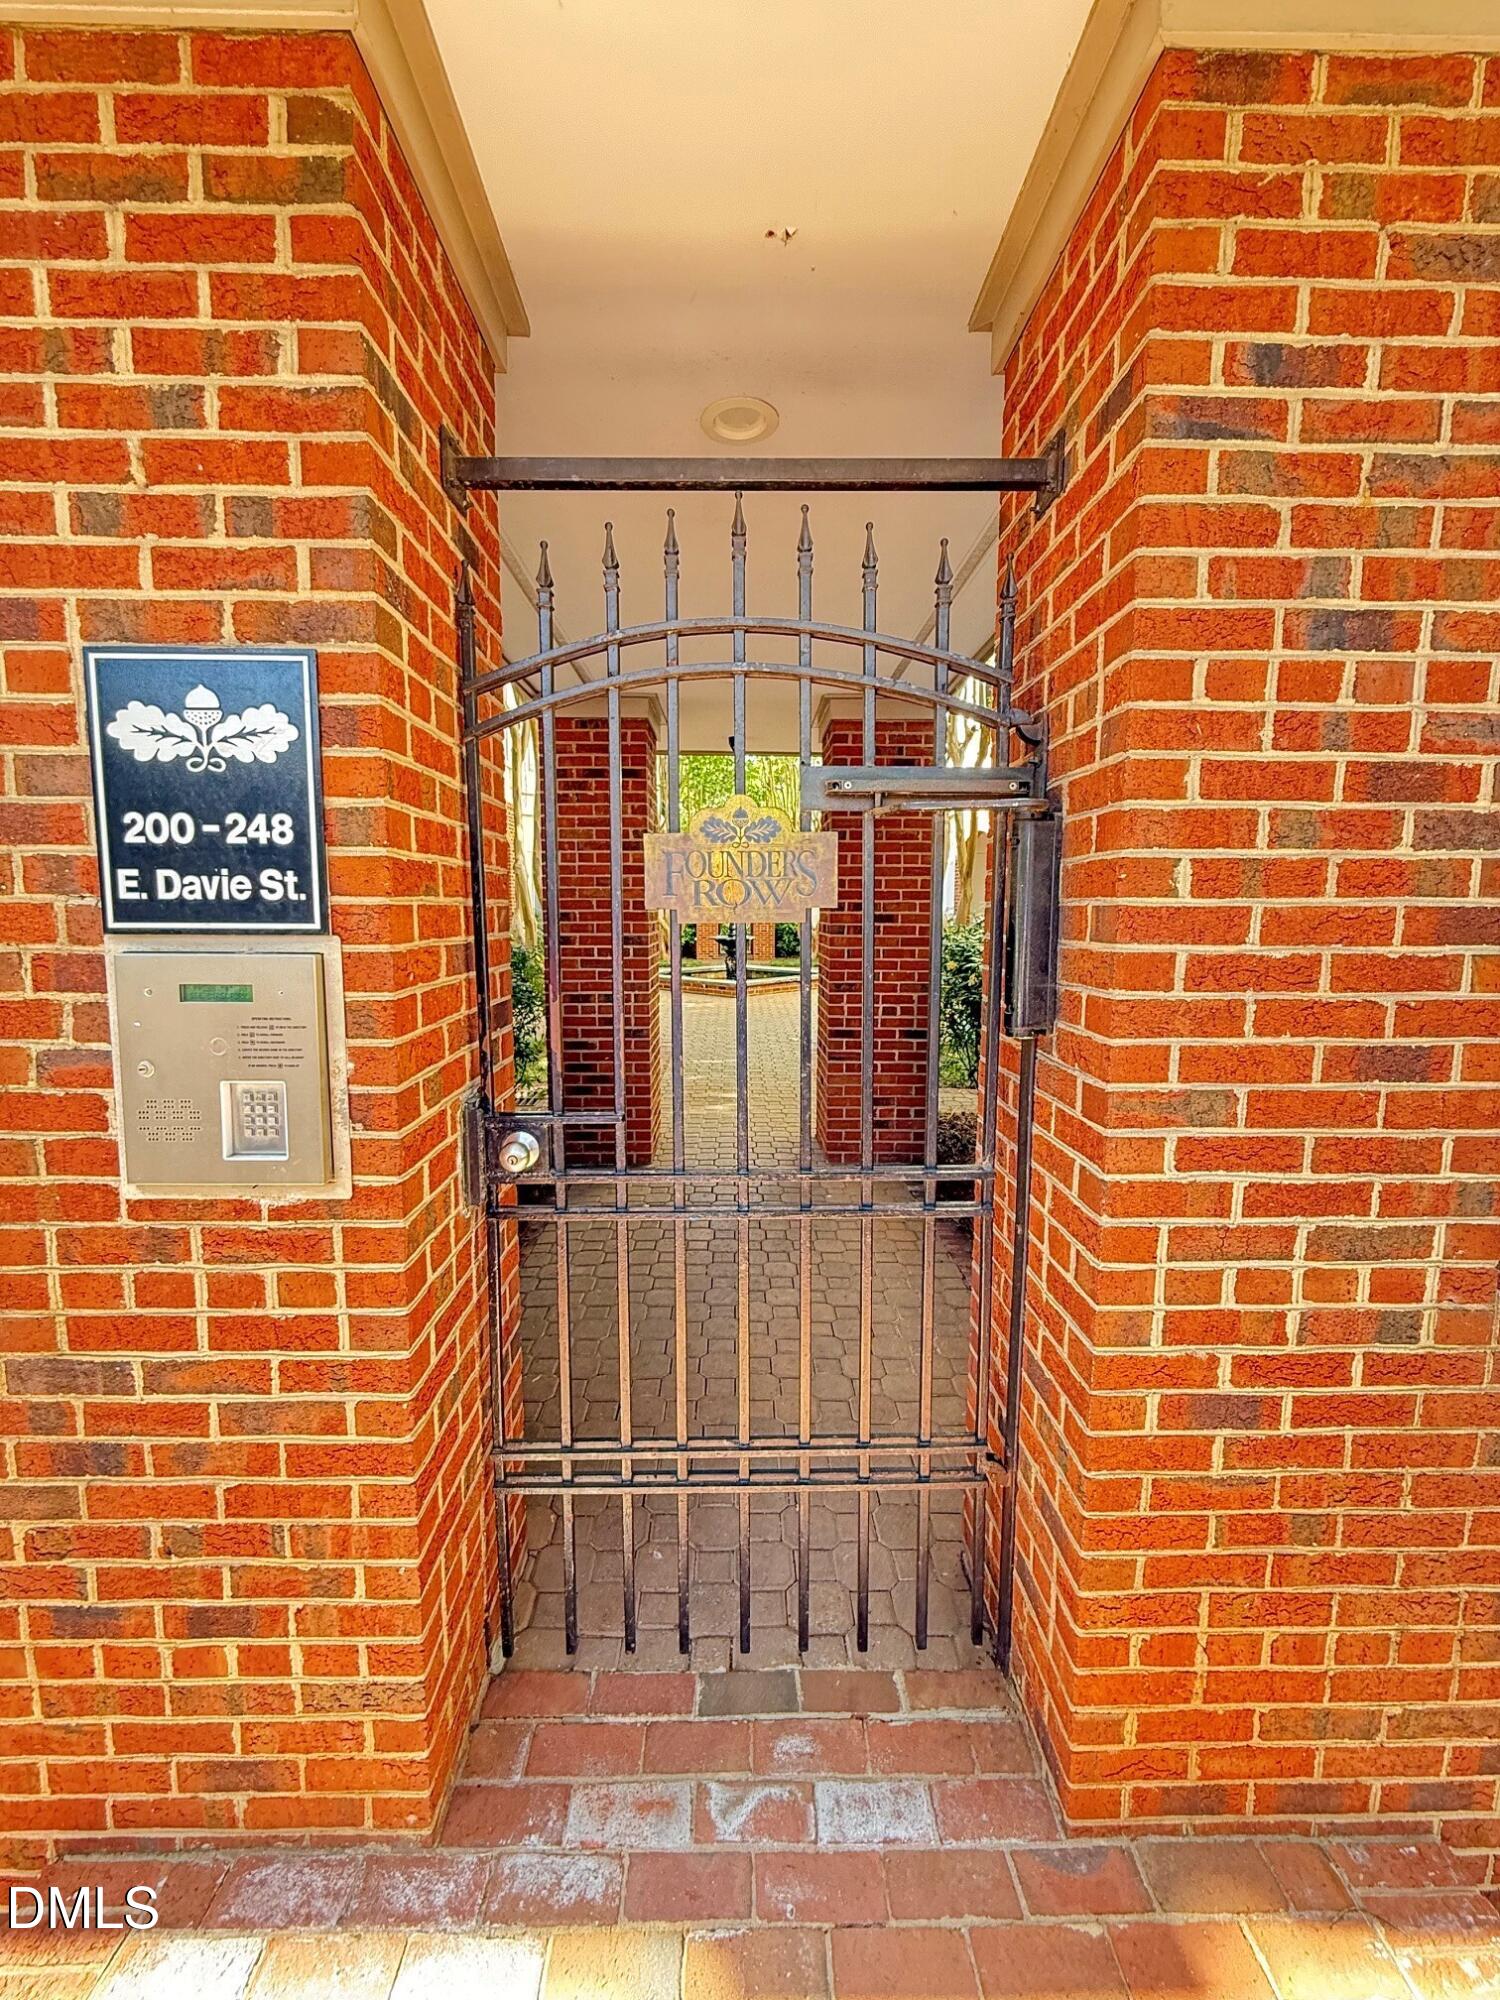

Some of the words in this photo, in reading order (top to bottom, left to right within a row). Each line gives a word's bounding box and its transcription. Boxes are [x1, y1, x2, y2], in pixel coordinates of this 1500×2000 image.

[116, 868, 148, 900] E.
[155, 868, 252, 900] Davie
[259, 868, 306, 901] St.
[662, 849, 818, 897] FOUNDERS
[693, 879, 792, 908] ROW
